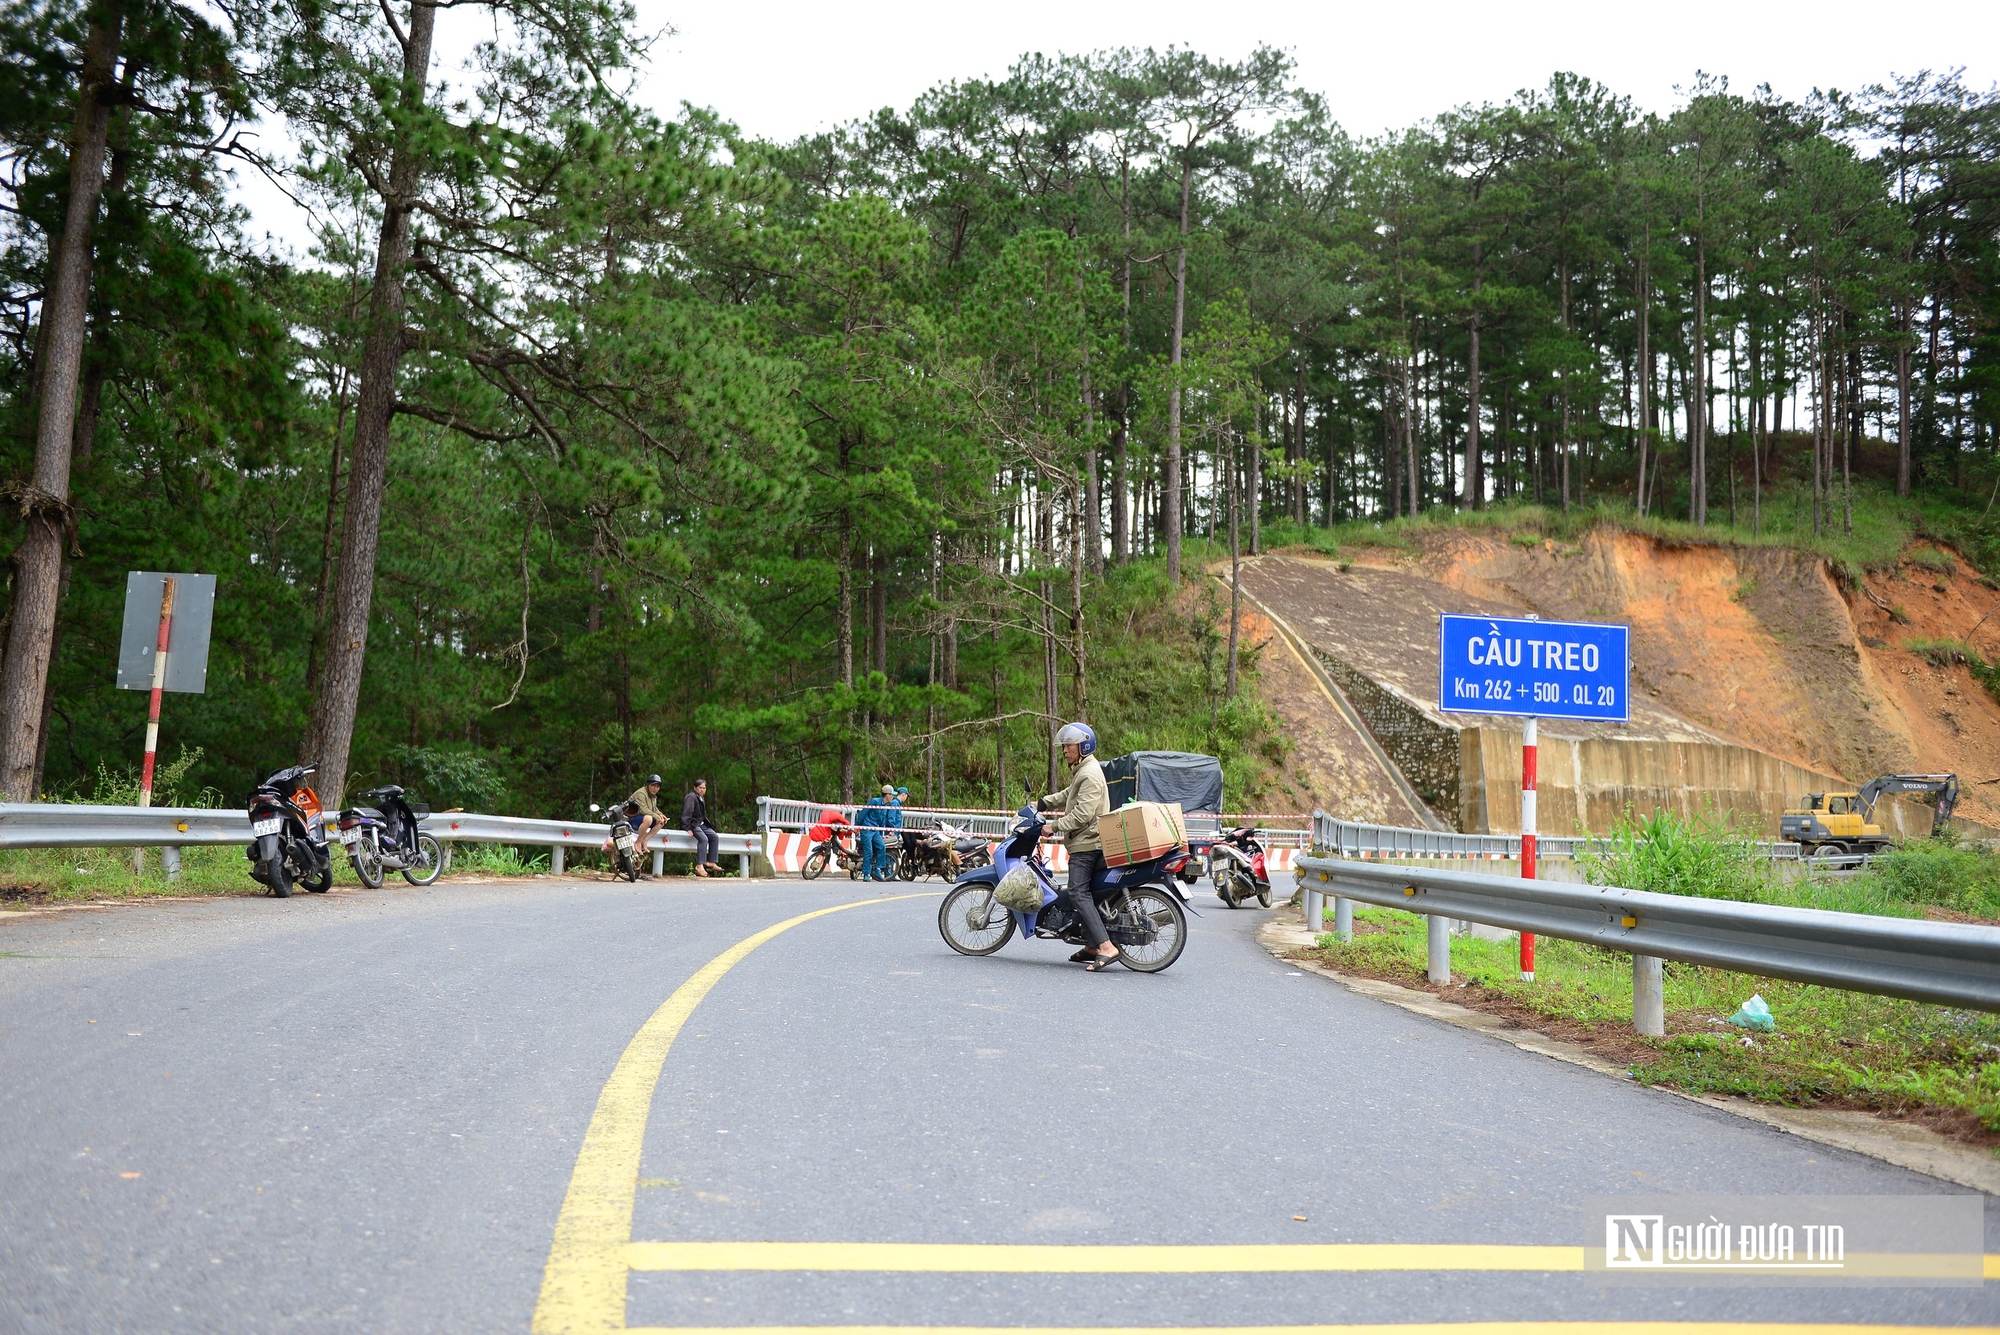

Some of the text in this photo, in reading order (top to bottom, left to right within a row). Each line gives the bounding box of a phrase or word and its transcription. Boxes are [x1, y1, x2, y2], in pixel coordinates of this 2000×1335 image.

[1468, 622, 1599, 672] CẦU TREO
[1454, 677, 1480, 699] Km
[1484, 678, 1512, 701] 262
[1533, 681, 1560, 703] 500
[1573, 684, 1593, 705] QL
[1597, 685, 1615, 707] 20
